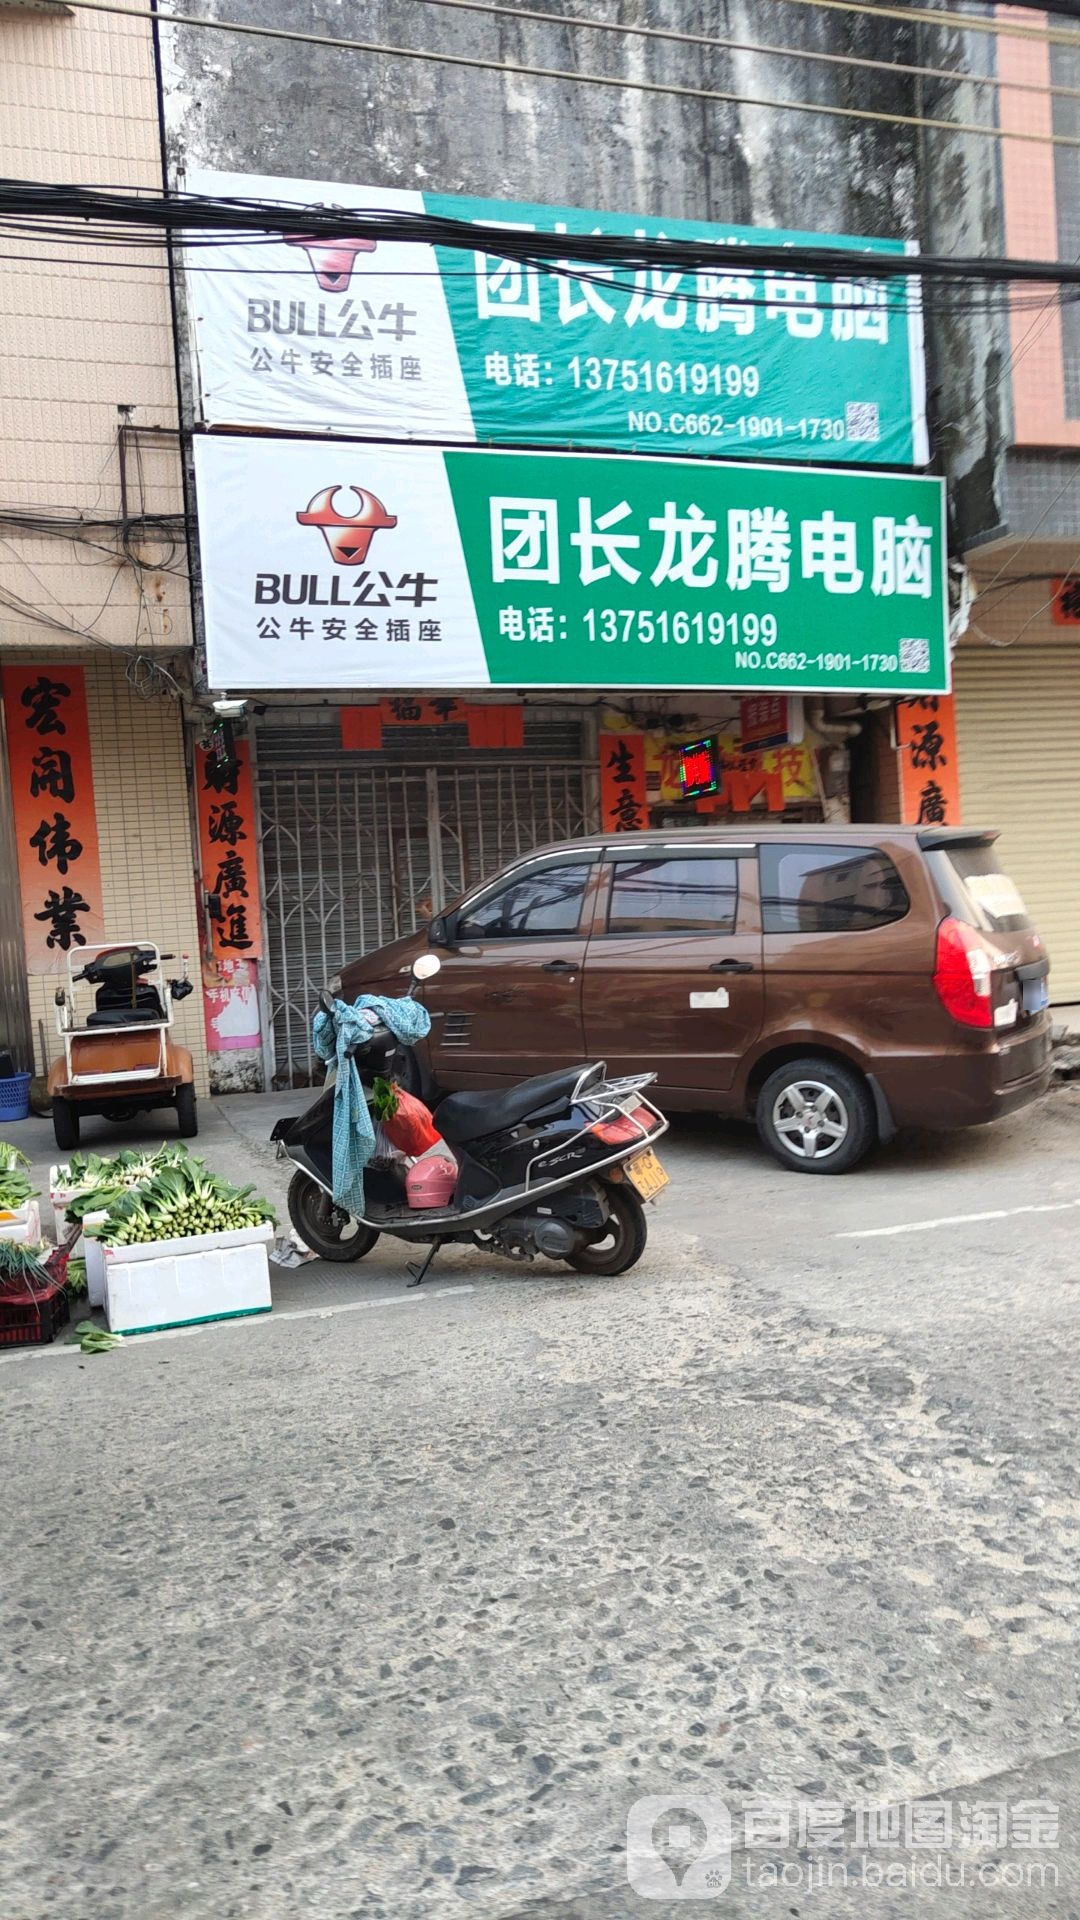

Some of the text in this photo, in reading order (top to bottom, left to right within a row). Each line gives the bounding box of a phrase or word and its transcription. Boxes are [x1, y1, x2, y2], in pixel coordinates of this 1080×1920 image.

[472, 219, 888, 344] 团长龙腾电脑
[247, 298, 418, 341] BULL公牛
[250, 347, 422, 381] 公牛安全插座
[568, 356, 760, 397] 13751619199
[628, 411, 845, 442] NO.C662-1901-1730
[489, 496, 933, 599] 团长龙腾电脑
[254, 571, 438, 607] BULL公牛
[256, 617, 442, 642] 公牛安全插座
[582, 609, 778, 646] 13751619199
